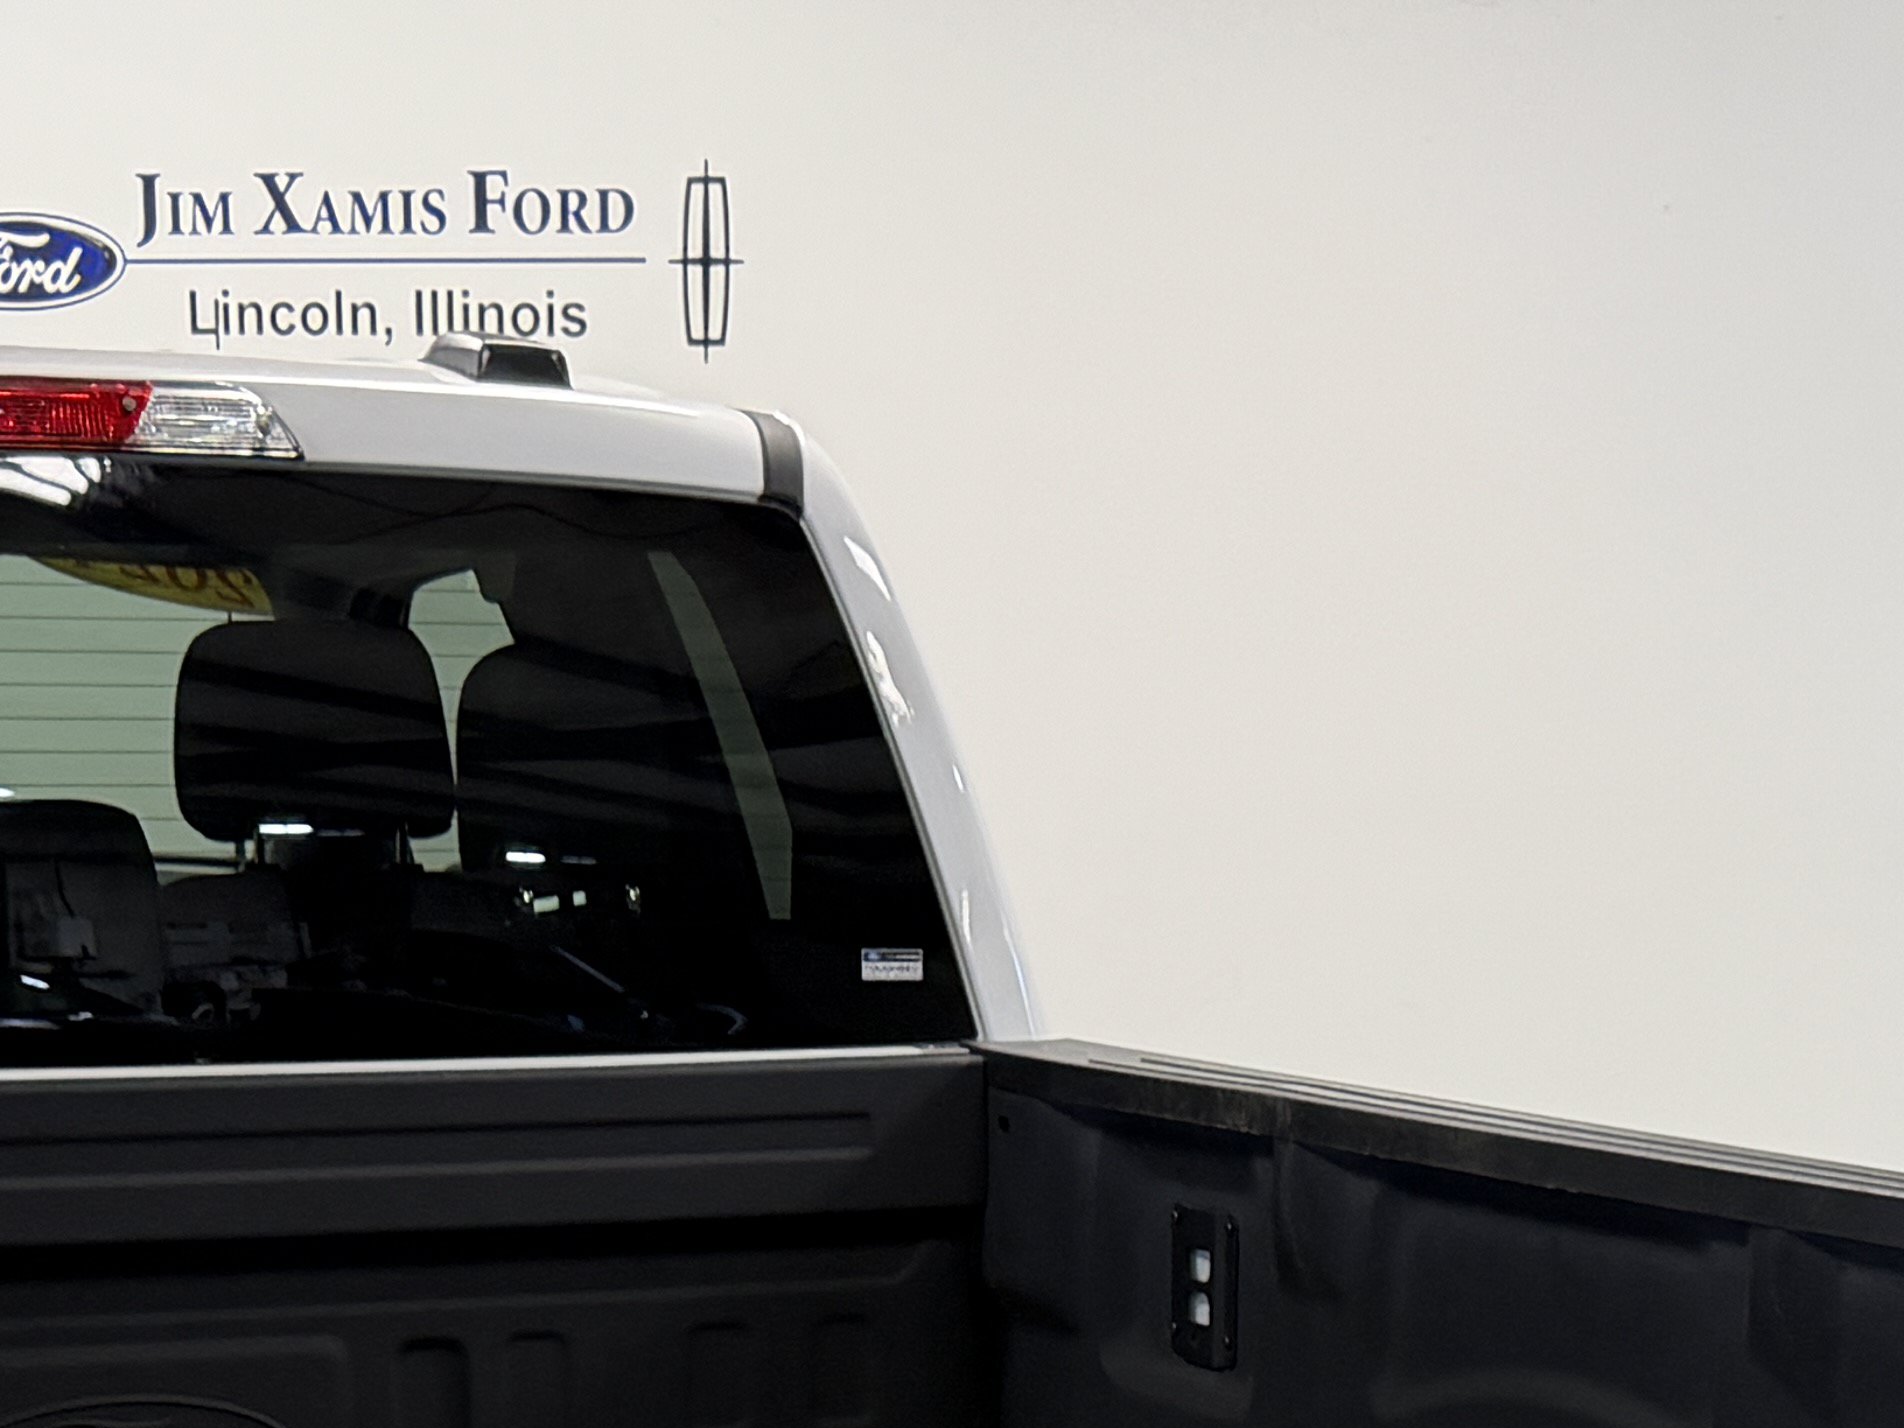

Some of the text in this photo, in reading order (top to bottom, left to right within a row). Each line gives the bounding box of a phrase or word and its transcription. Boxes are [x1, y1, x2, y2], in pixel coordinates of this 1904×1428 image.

[136, 170, 634, 248] JIM XAMIS FORD
[189, 289, 587, 347] Lincoln, Illinois
